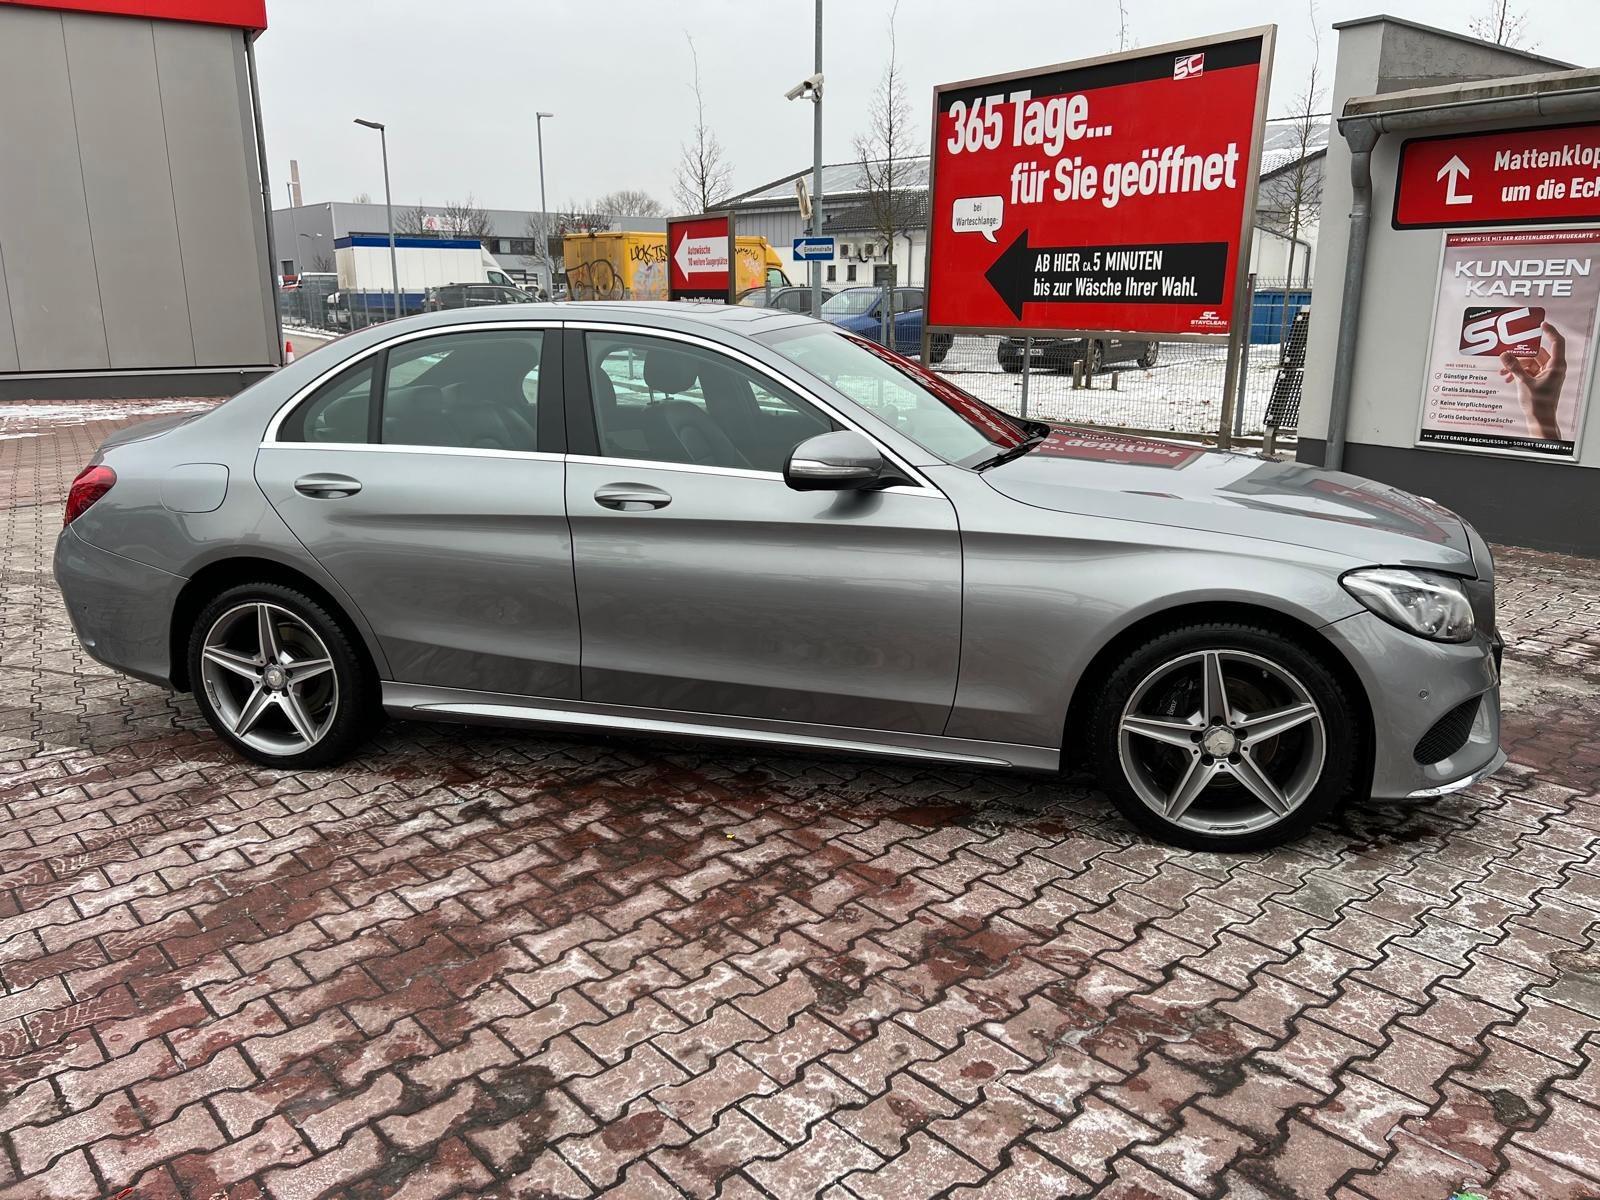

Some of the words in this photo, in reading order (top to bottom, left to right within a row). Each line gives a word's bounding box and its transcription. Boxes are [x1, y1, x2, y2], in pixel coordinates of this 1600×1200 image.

[1174, 53, 1204, 80] SC
[947, 94, 1004, 155] 365
[1009, 89, 1113, 157] Tage...
[1010, 161, 1050, 205] für
[1053, 156, 1098, 202] Sie
[1101, 143, 1240, 209] geöffnet
[1501, 184, 1531, 203] um
[1536, 178, 1566, 200] die
[973, 202, 983, 212] bei
[956, 216, 999, 227] Warteschlange:
[1035, 254, 1050, 272] AB
[1053, 253, 1081, 272] HIER
[1093, 252, 1101, 271] 5
[1105, 250, 1163, 271] MINUTEN
[1455, 259, 1591, 277] KUNDEN
[1033, 278, 1050, 296] bis
[1053, 282, 1072, 296] zur
[1075, 277, 1121, 296] Wäsche
[1125, 277, 1158, 297] Ihrer
[1162, 276, 1198, 297] Wahl.
[1465, 280, 1573, 297] KARTE
[1200, 311, 1219, 319] SC
[1460, 307, 1542, 355] SC
[1443, 373, 1468, 381] Günstige
[1456, 400, 1503, 409] Verpflichtungen
[1468, 437, 1508, 445] ABSCHLIESSEN
